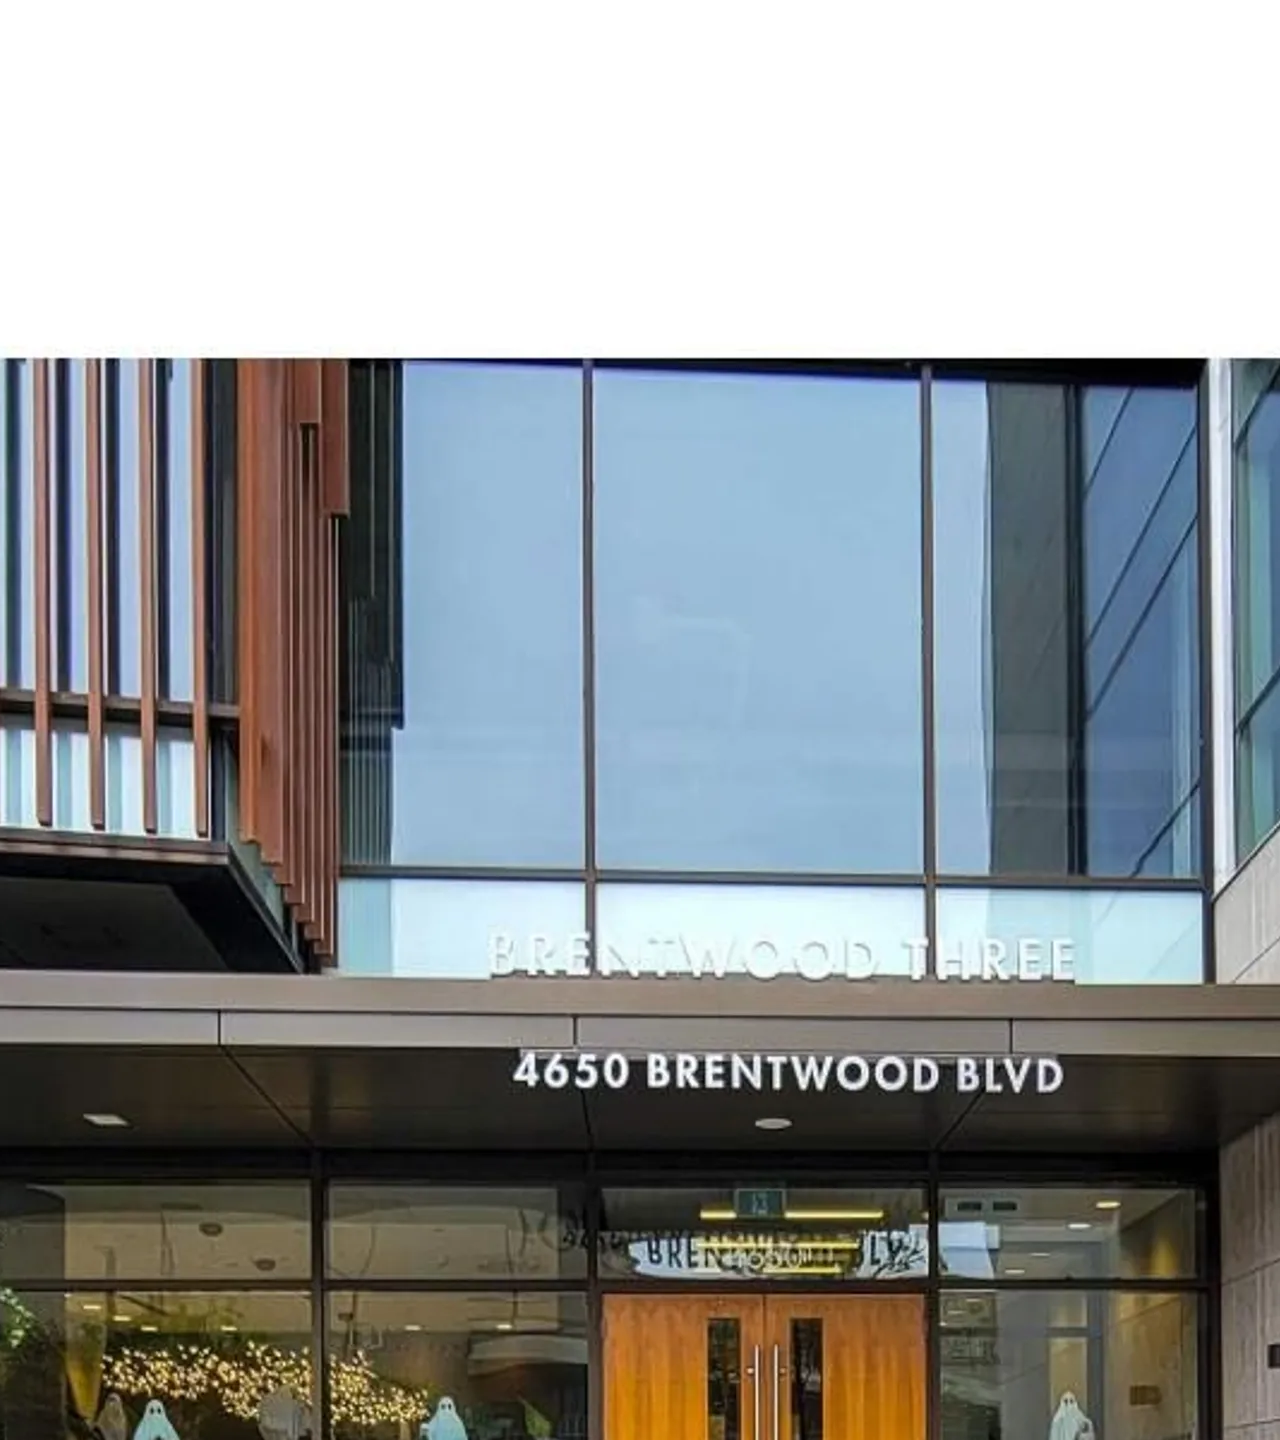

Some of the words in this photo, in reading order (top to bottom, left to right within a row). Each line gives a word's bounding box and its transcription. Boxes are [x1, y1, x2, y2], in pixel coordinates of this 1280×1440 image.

[488, 932, 877, 981] BRENTWOOD
[901, 938, 1076, 981] THREE
[512, 1052, 629, 1089] 4650
[647, 1053, 939, 1092] BRENTWOOD
[956, 1057, 1064, 1093] BLVD
